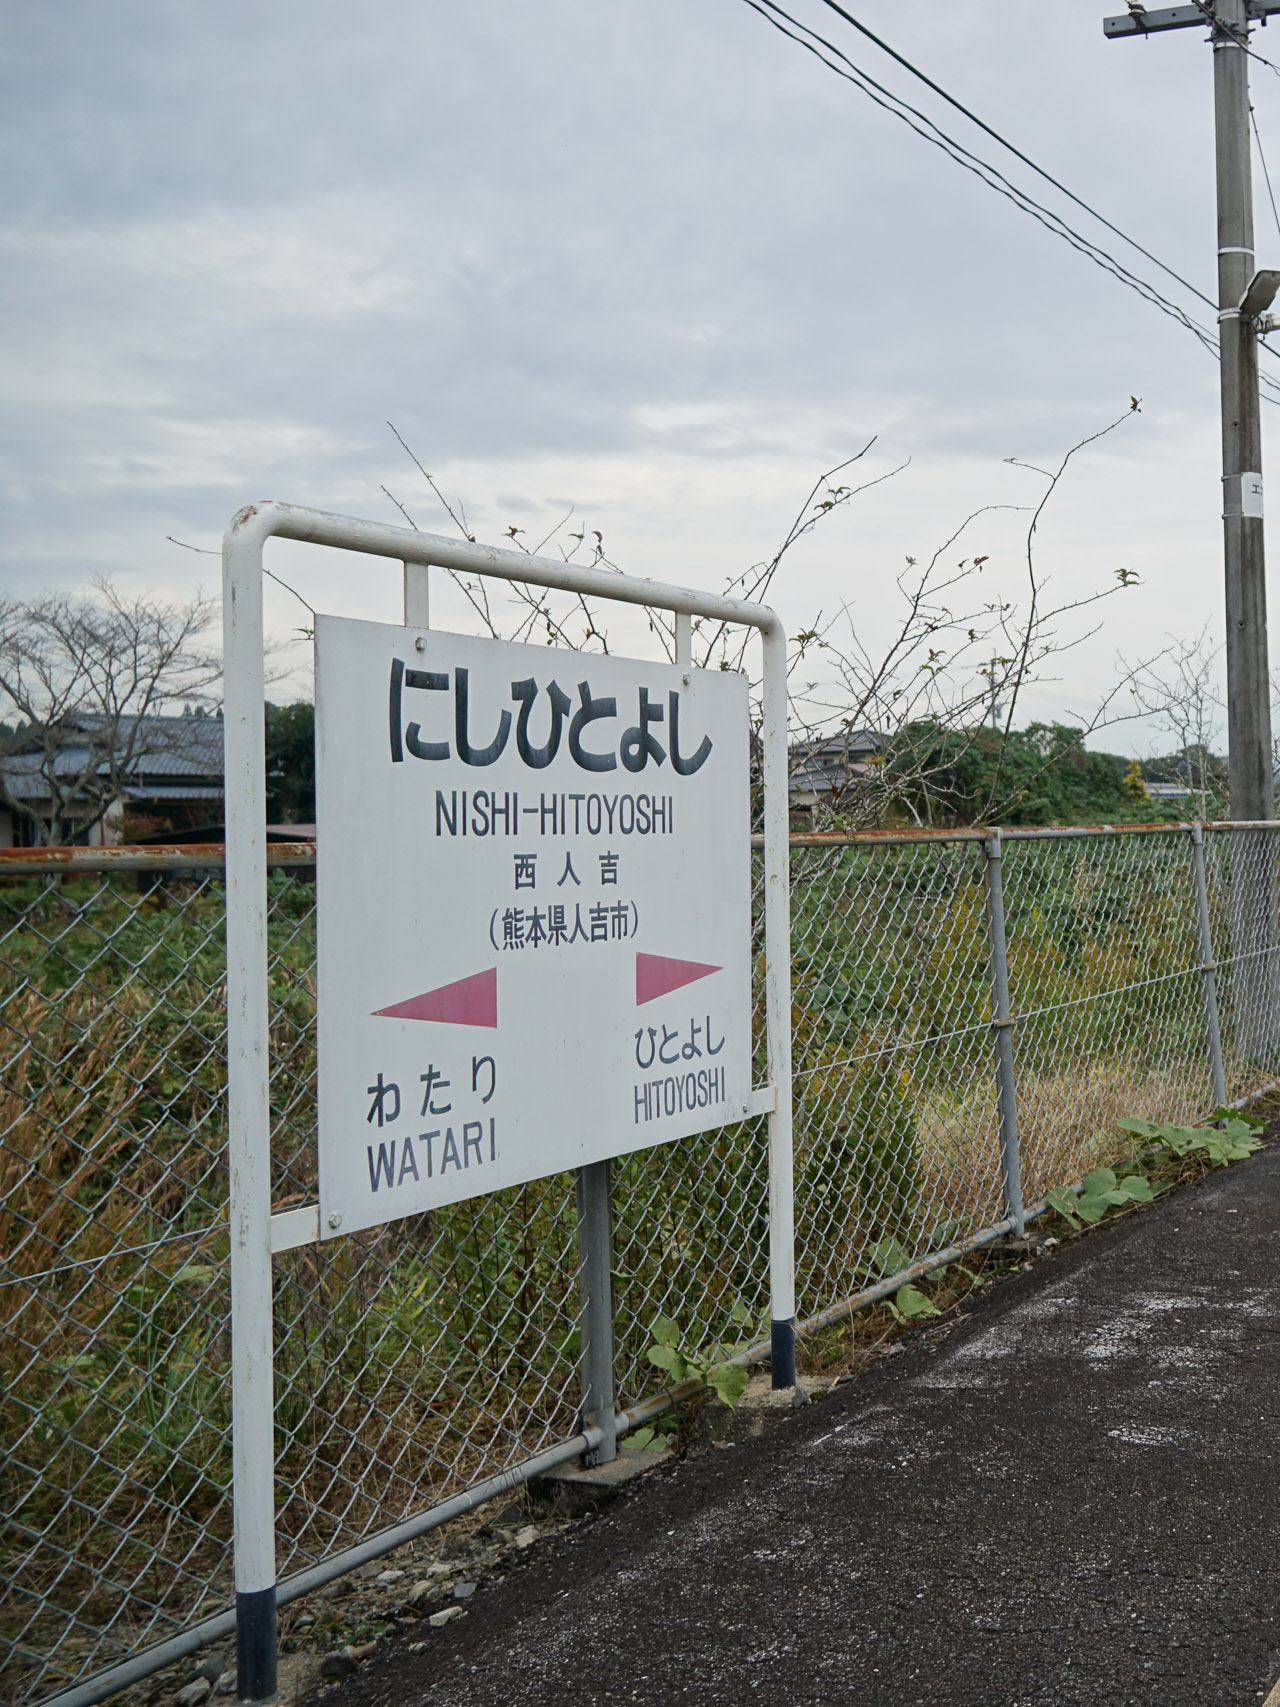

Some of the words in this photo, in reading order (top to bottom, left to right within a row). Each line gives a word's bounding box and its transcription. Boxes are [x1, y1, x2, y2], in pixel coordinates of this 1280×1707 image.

[388, 656, 714, 776] にしひとよし
[435, 790, 673, 837] NISHI-HITOYOSHI
[489, 899, 639, 951] (熊本県人吉市)
[634, 1015, 726, 1070] ひとよし
[634, 1066, 726, 1124] HITOYOSHI
[366, 1117, 496, 1193] WATARI
